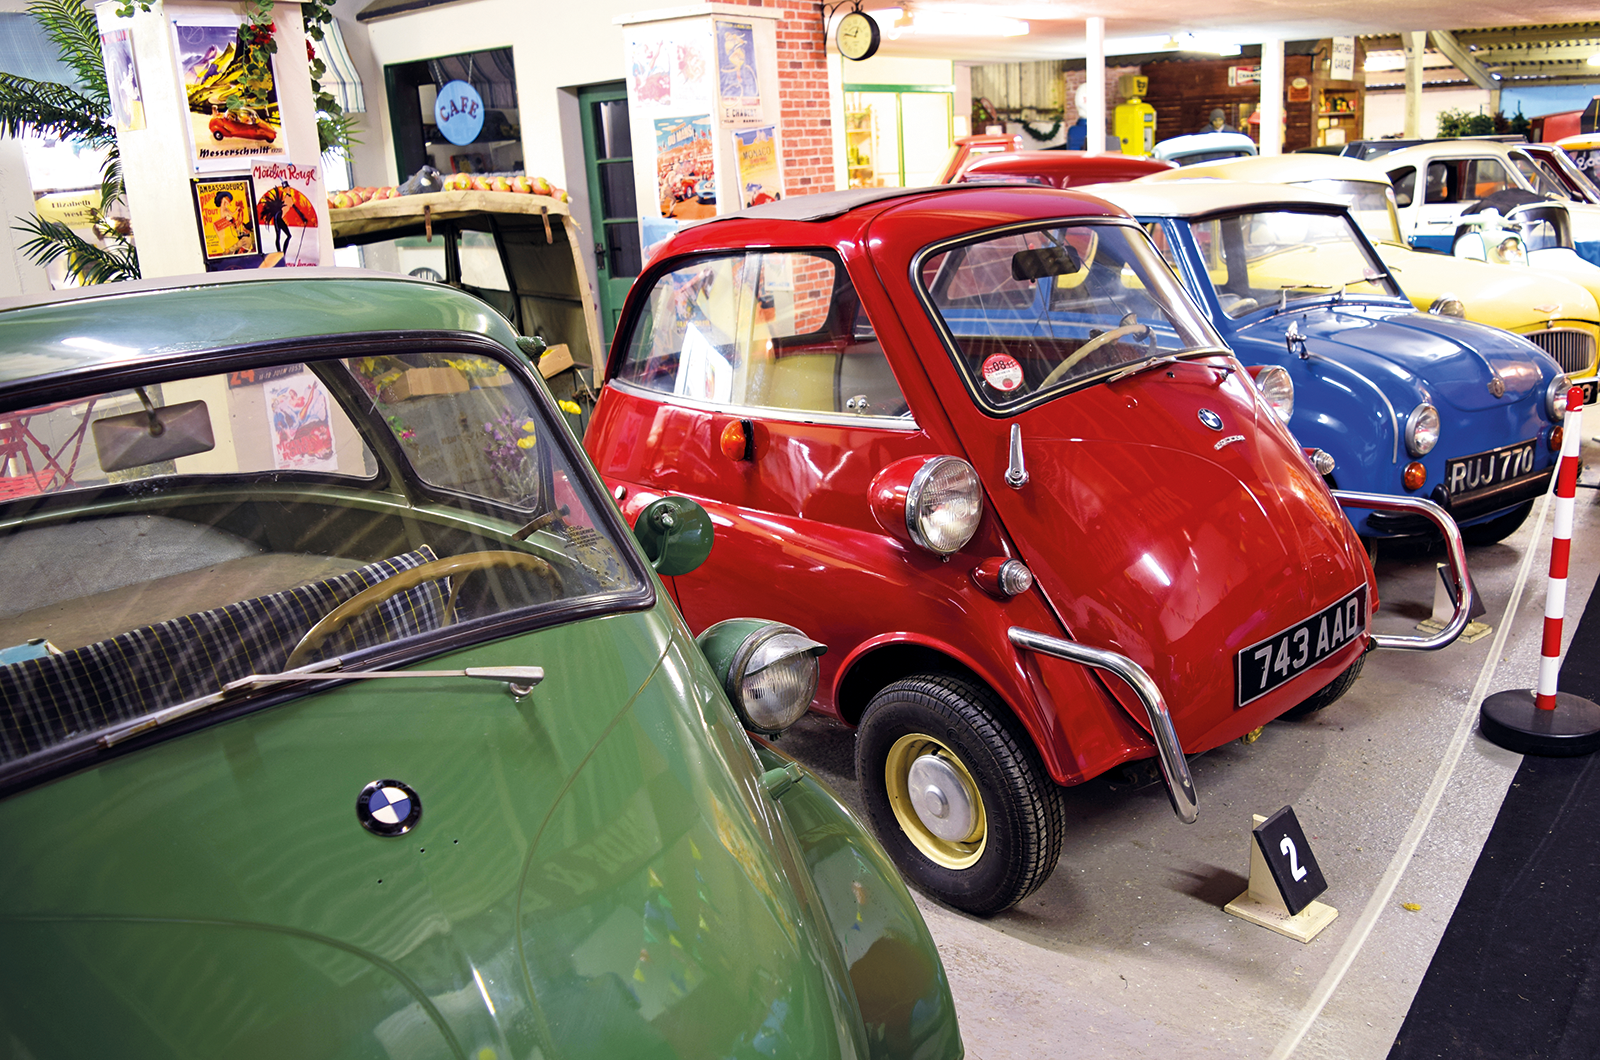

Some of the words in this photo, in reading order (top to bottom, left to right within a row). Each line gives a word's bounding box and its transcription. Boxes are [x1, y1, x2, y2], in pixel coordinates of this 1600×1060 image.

[440, 95, 479, 123] CAFE
[200, 146, 270, 158] Messerschmitt
[743, 147, 772, 160] MONACO
[253, 163, 287, 180] Moulin
[286, 163, 317, 186] Rouge
[199, 182, 245, 194] AMBASSADEURS
[51, 199, 91, 209] Elizabeth
[63, 210, 83, 218] West
[204, 208, 218, 216] TOUT
[203, 215, 213, 226] NU
[993, 360, 1006, 371] 08
[1450, 455, 1495, 493] RUJ
[1500, 446, 1534, 481] 770
[1254, 627, 1309, 689] 743
[1315, 597, 1358, 658] AAD
[1280, 837, 1307, 882] 2
